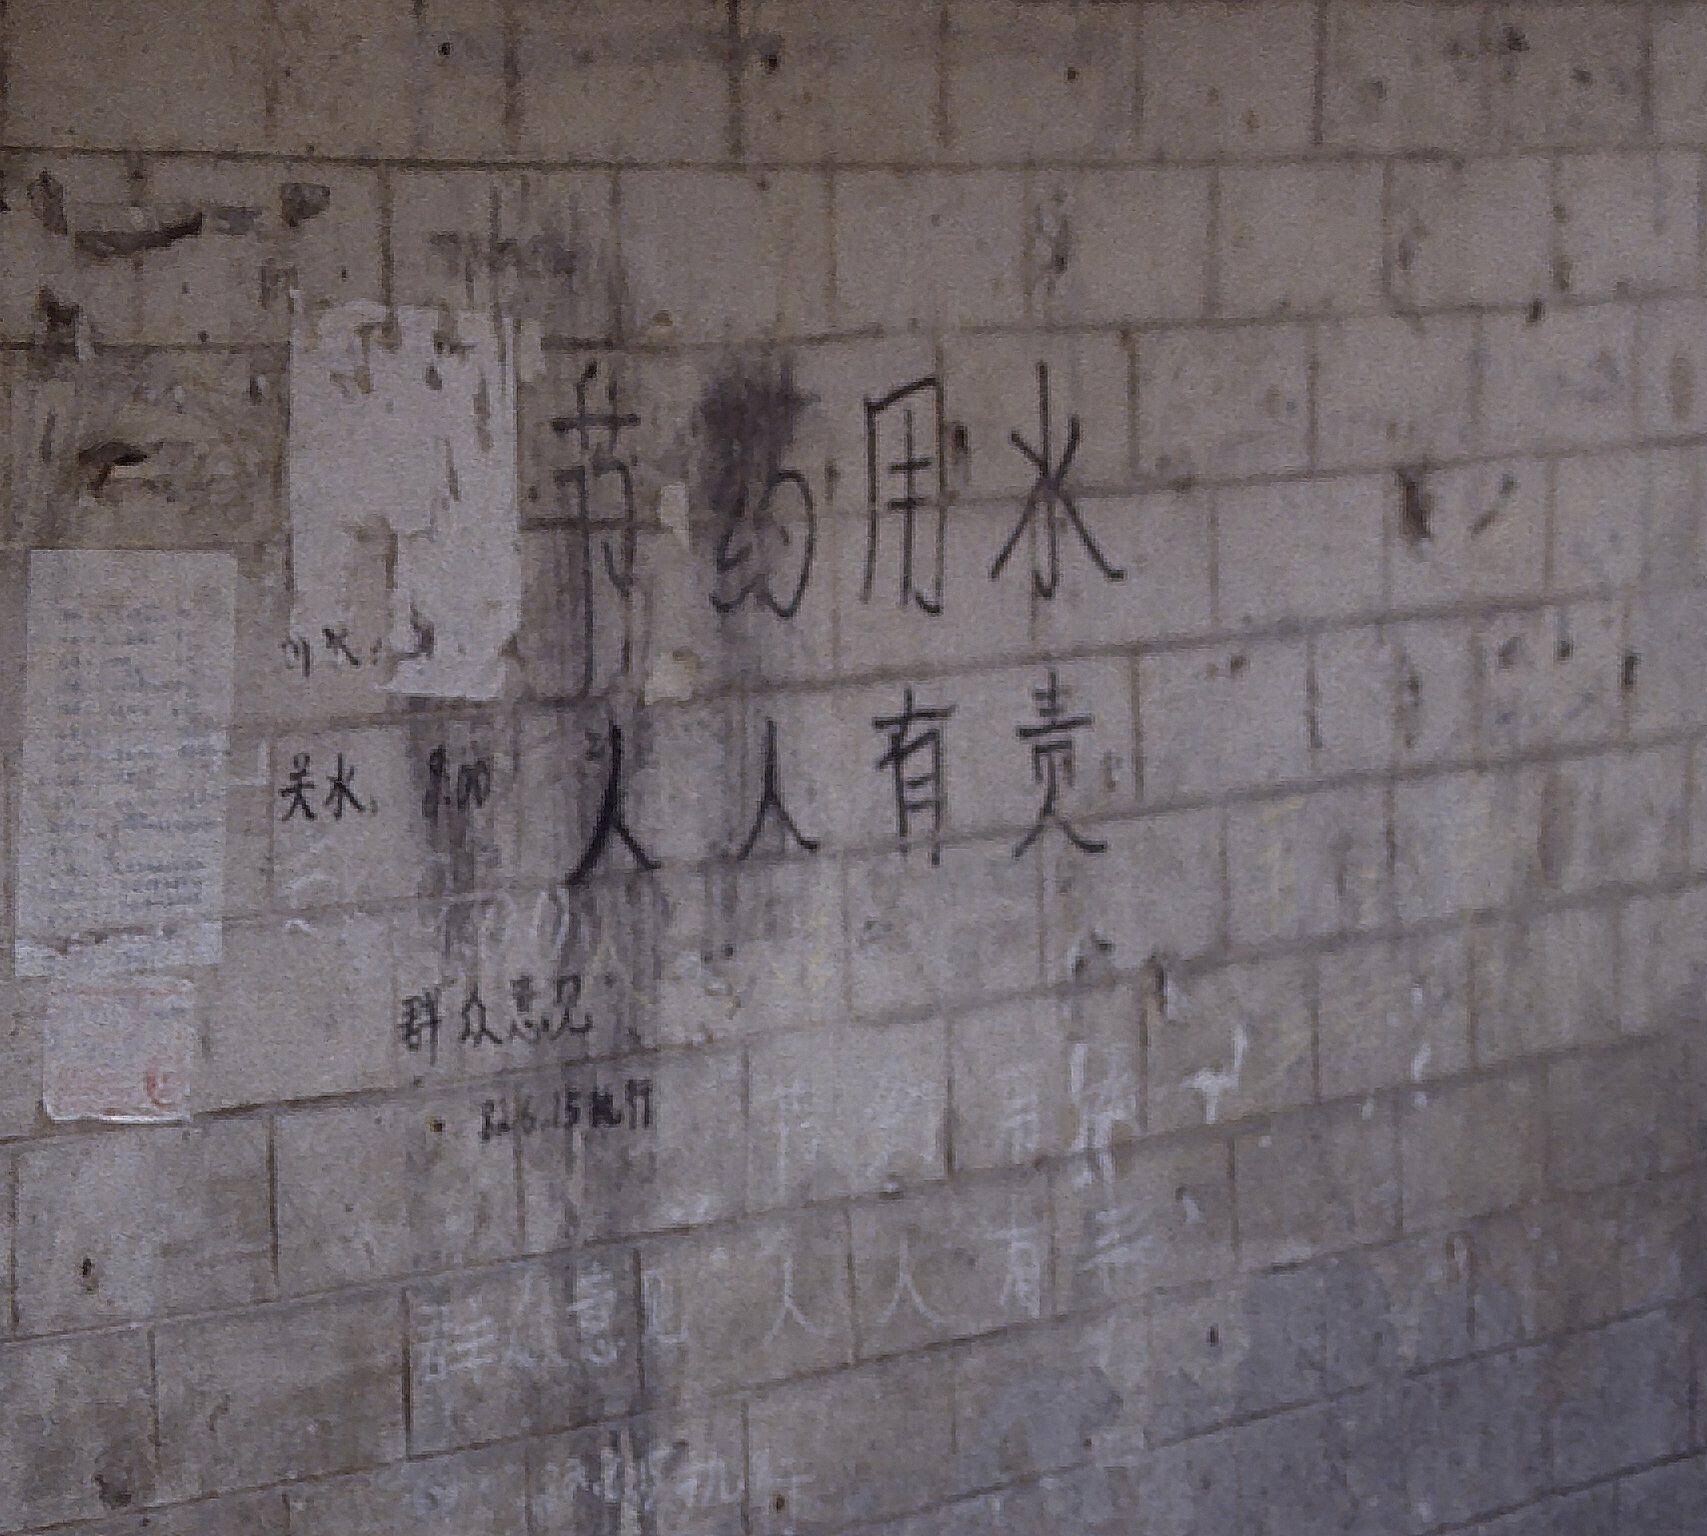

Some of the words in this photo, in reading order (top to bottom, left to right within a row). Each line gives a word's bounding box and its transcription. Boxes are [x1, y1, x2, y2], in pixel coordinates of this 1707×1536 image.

[551, 360, 1128, 702] 节约用水
[564, 668, 1108, 888] 人人有责
